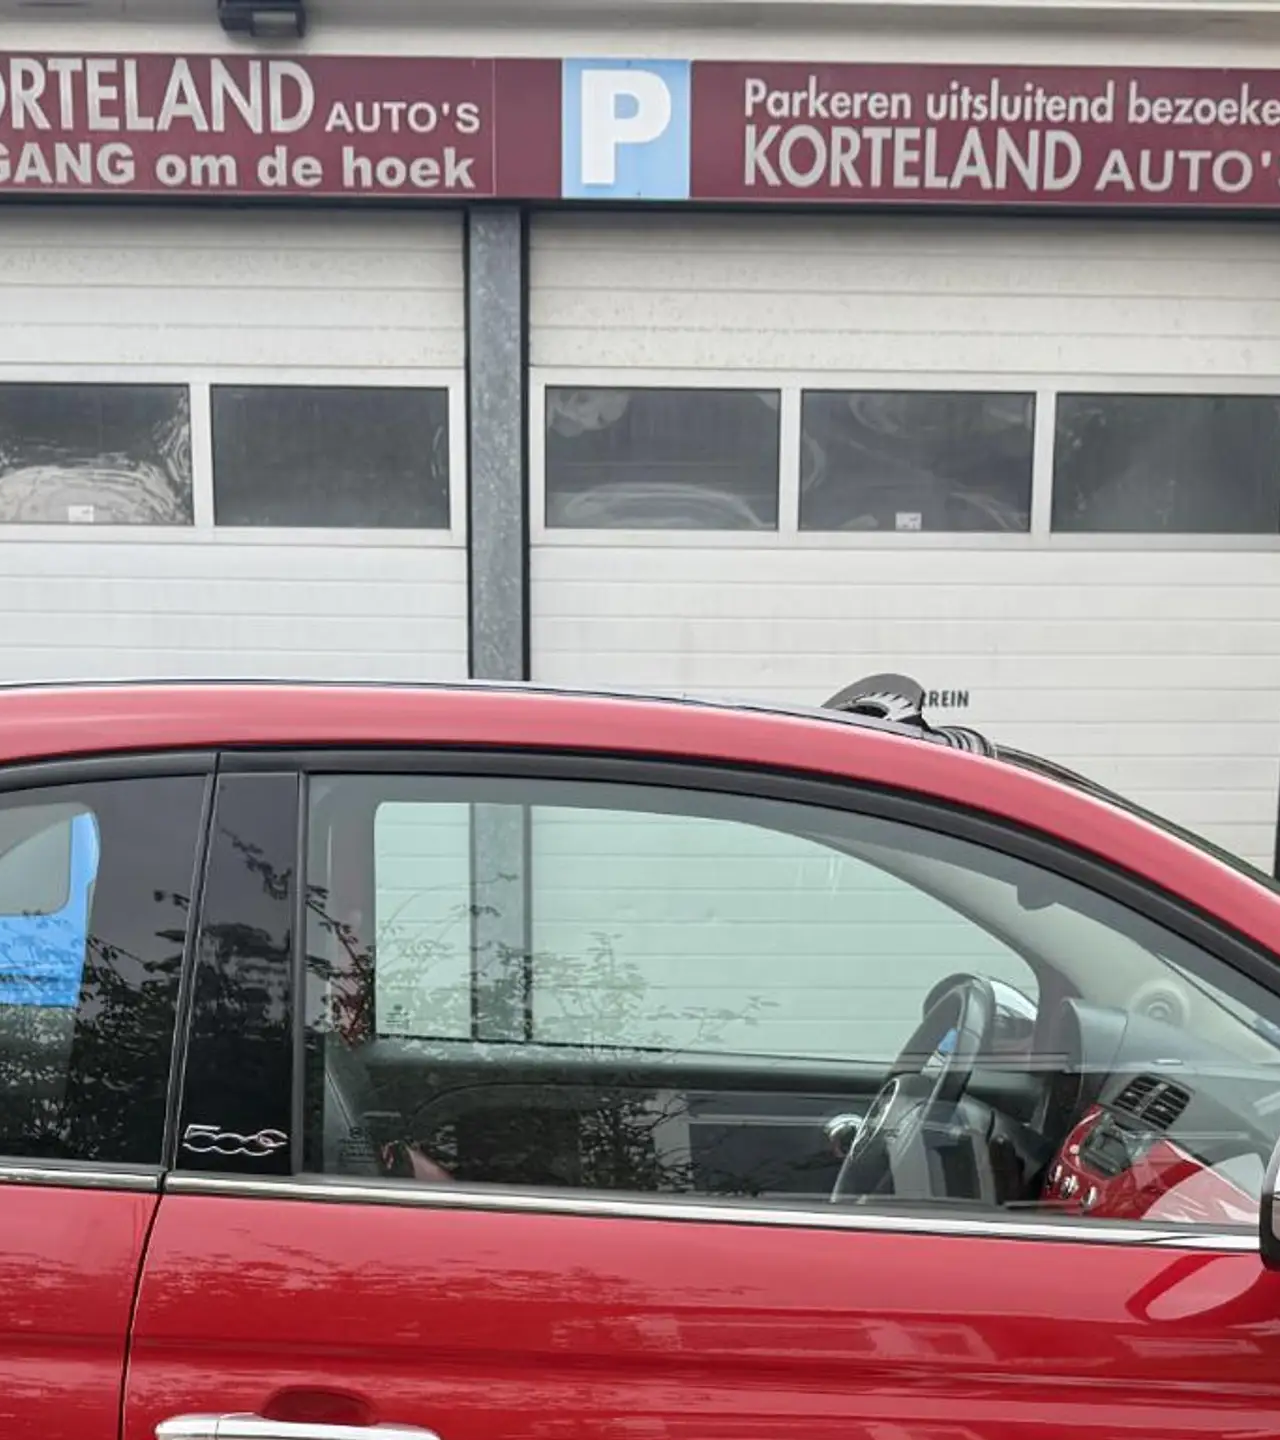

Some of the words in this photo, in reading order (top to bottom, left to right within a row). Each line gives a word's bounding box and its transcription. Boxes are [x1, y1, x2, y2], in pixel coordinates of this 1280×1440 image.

[324, 101, 481, 134] AUTO'S
[743, 75, 913, 120] Parkeren
[925, 78, 1116, 124] uitsluitend
[580, 68, 672, 185] P
[154, 153, 238, 187] om
[256, 144, 324, 188] de
[341, 145, 477, 189] hoek
[743, 124, 1083, 192] KORTELAND
[922, 690, 969, 708] REIN
